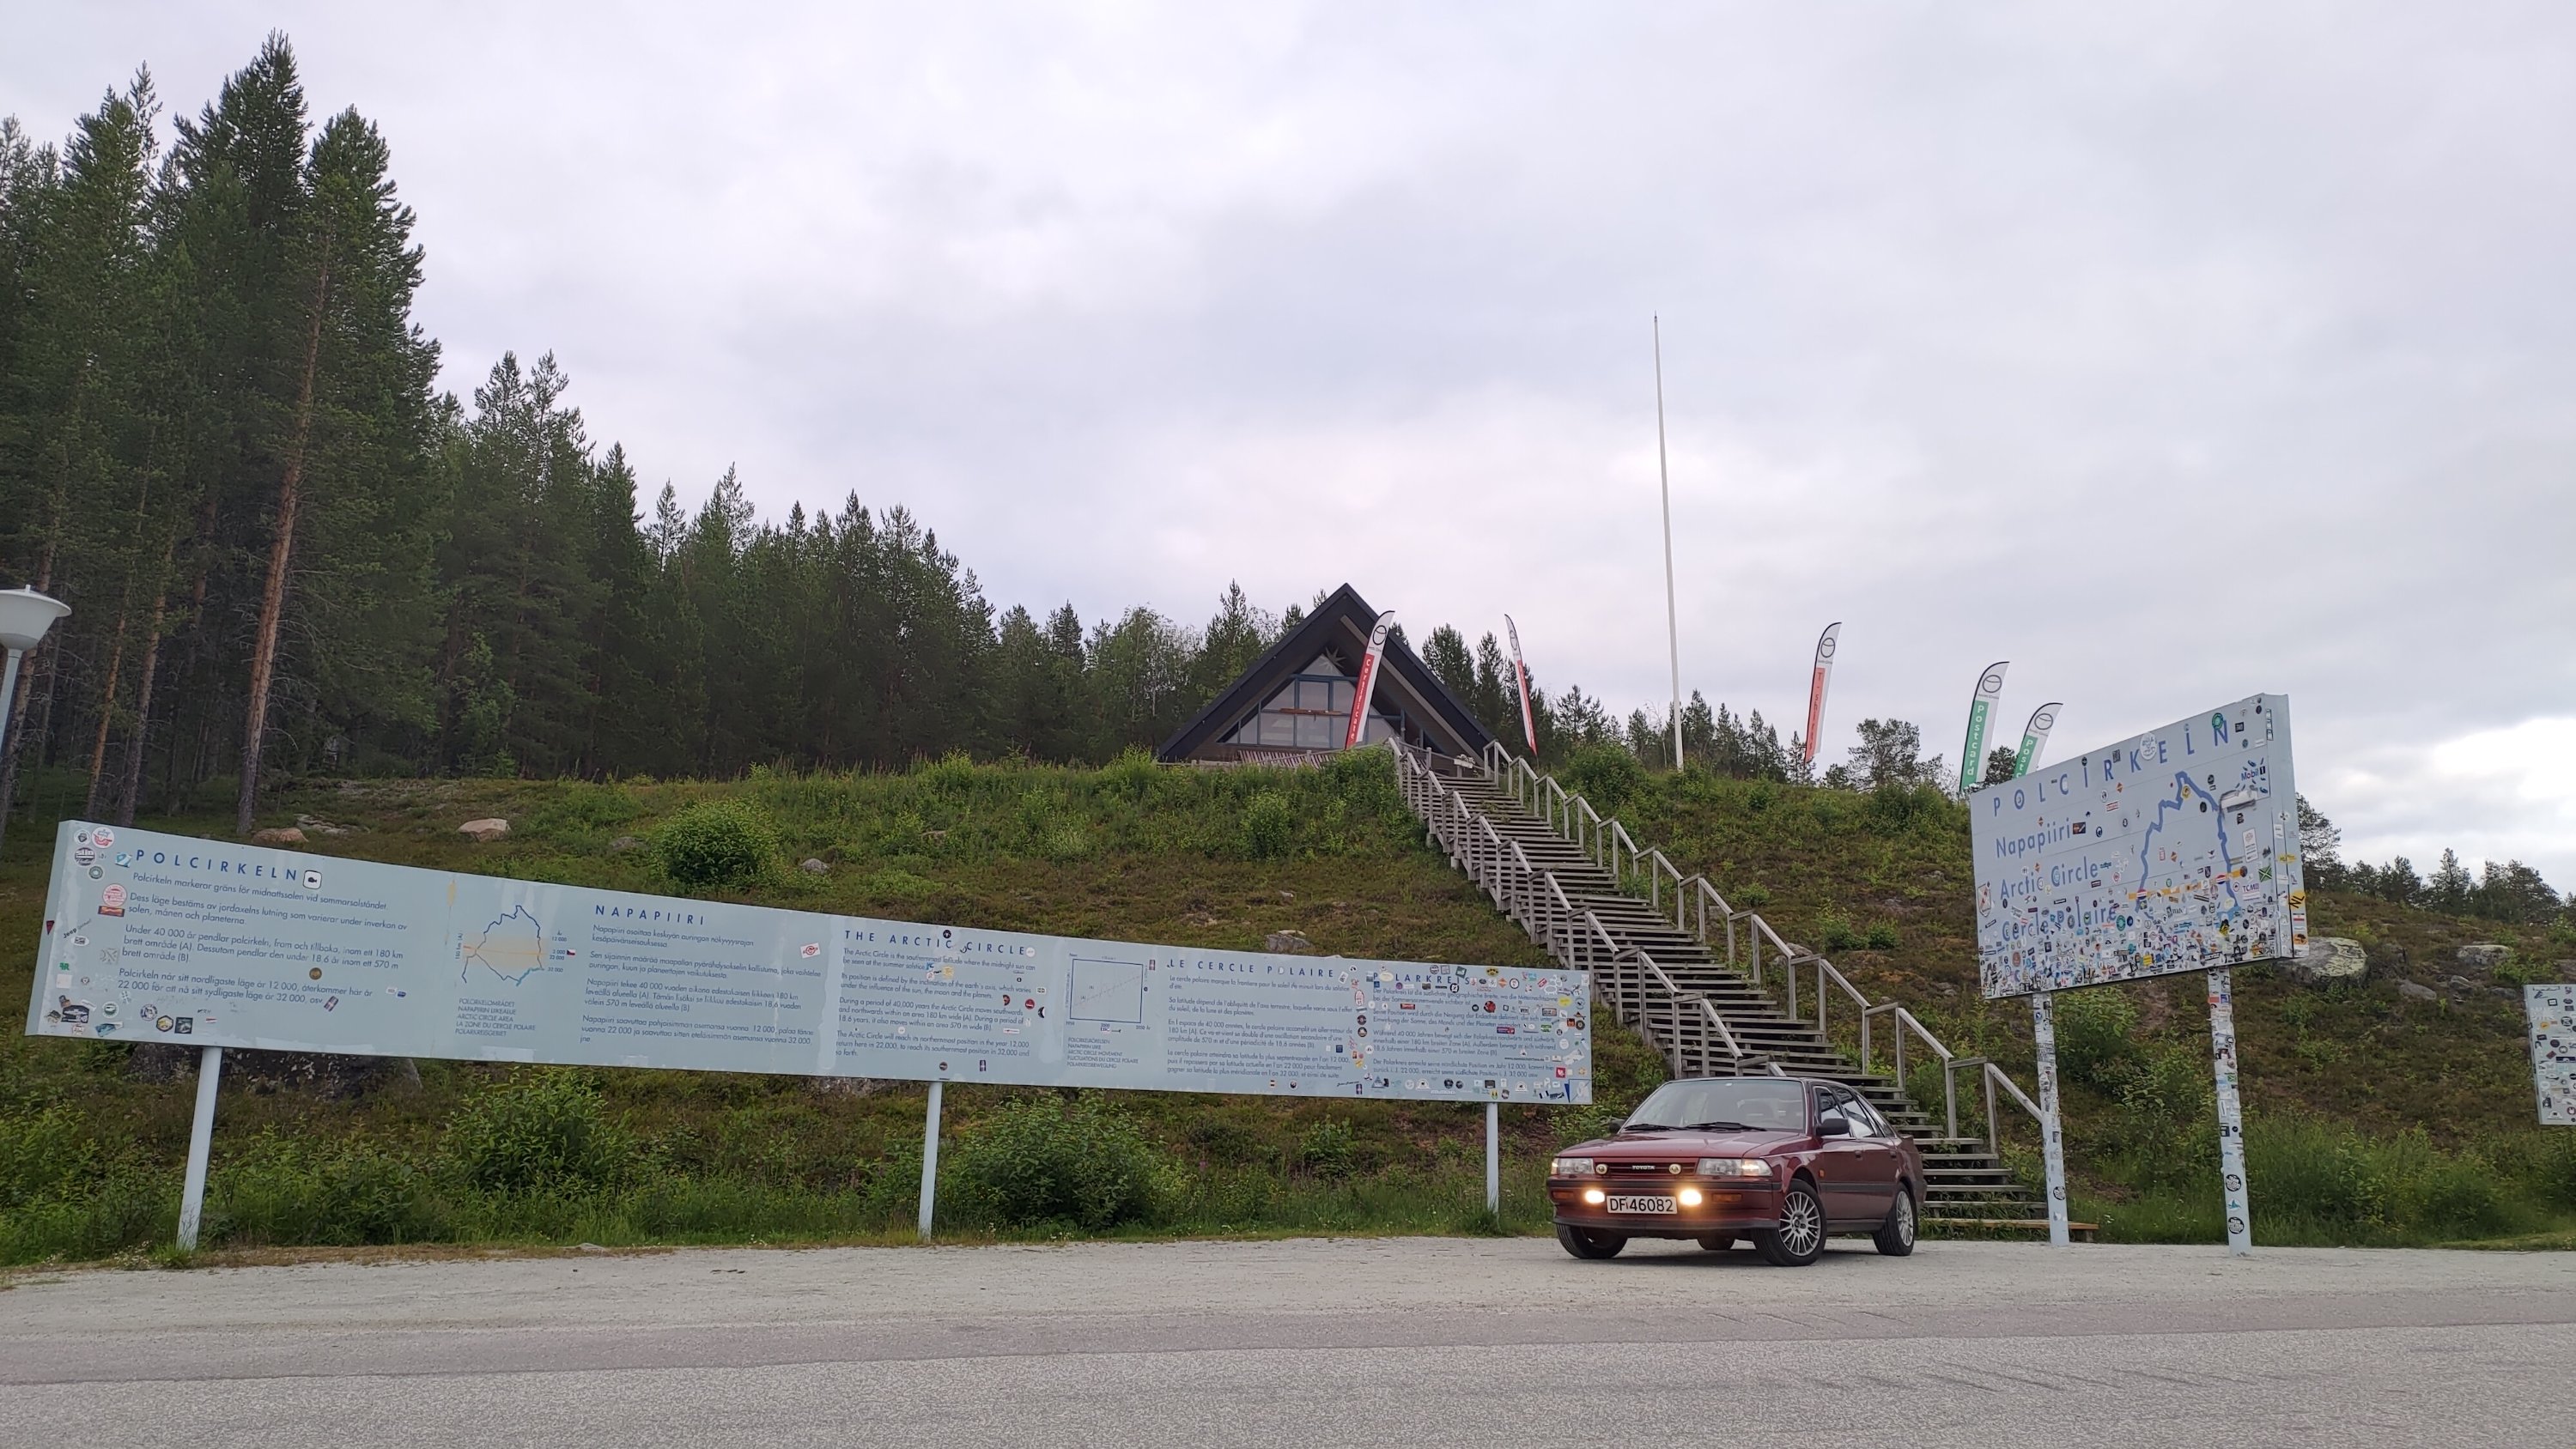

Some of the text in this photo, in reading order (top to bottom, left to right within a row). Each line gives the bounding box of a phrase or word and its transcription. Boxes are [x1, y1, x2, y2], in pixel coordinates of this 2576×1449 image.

[1967, 705, 1984, 776] Postcard
[1993, 719, 2229, 817] POLCIRKELN
[2241, 768, 2259, 781] Mobil
[1996, 817, 2071, 859] Napapiiri
[136, 849, 297, 881] POLCIRKELN
[133, 872, 171, 885] Polcirkeln
[174, 878, 211, 889] markerar
[214, 882, 236, 892] gräns
[239, 884, 249, 894] för
[252, 886, 303, 900] midnattssolen
[306, 892, 318, 901] vid
[2000, 856, 2099, 900] Arctic Circle
[129, 904, 152, 915] solen,
[155, 906, 182, 917] månen
[185, 910, 200, 919] och
[130, 892, 149, 902] Dess
[152, 894, 169, 906] läge
[172, 896, 204, 908] bestäms
[219, 901, 259, 914] jordaxelns
[262, 906, 287, 919] lutning
[308, 912, 338, 923] varierar
[340, 915, 362, 925] under
[365, 917, 395, 929] inverkan
[2289, 895, 2306, 909] NL
[595, 904, 705, 926] NAPAPIIRI
[2002, 912, 2049, 942] Cercle
[2057, 901, 2117, 931] Plaire
[125, 923, 151, 935] Under
[154, 926, 165, 936] 40
[167, 927, 185, 938] 000
[187, 929, 196, 939] år
[198, 931, 229, 942] pendlar
[231, 934, 271, 947] polcirkeln,
[274, 937, 291, 948] fram
[294, 940, 308, 950] och
[343, 944, 361, 955] inom
[364, 948, 373, 956] ett
[376, 947, 390, 957] 180
[392, 949, 403, 959] km
[593, 923, 625, 935] Napapiiri
[122, 946, 141, 957] brett
[143, 949, 175, 960] område
[124, 934, 143, 946] brett
[145, 938, 176, 949] område
[197, 941, 234, 954] Dessutom
[237, 946, 267, 957] pendlar
[269, 948, 283, 959] den
[286, 950, 308, 961] under
[331, 953, 338, 963] år
[342, 954, 360, 965] inom
[363, 958, 372, 966] ett
[374, 957, 390, 968] 570
[845, 930, 1025, 955] THE ARCTIC CIRCLE
[1170, 959, 1185, 968] LE
[1198, 961, 1254, 973] CERCLE
[117, 978, 129, 989] 22
[131, 979, 149, 990] 000
[152, 981, 163, 991] för
[166, 984, 176, 992] att
[178, 983, 189, 993] nå
[192, 984, 203, 994] sitt
[205, 986, 243, 999] sydligaste
[246, 988, 263, 1001] läge
[265, 990, 273, 1000] år
[277, 991, 287, 1001] 32
[119, 967, 372, 996] Polcirkeln når sitt nordligaste läge år 12 000, återkommer här år
[1373, 972, 1470, 985] PLARKREIS
[606, 997, 619, 1006] 570
[839, 995, 858, 1007] During
[866, 997, 884, 1007] period
[885, 998, 891, 1006] of
[931, 1001, 939, 1010] the
[941, 1002, 956, 1011] Arctic
[958, 1003, 973, 1012] Circle
[993, 1005, 1023, 1015] southwards
[851, 1006, 883, 1015] northwards
[884, 1007, 901, 1016] within
[927, 1010, 937, 1018] 180
[939, 1011, 947, 1019] km
[948, 1011, 961, 1020] wide
[974, 1013, 993, 1024] During
[999, 1015, 1017, 1024] period
